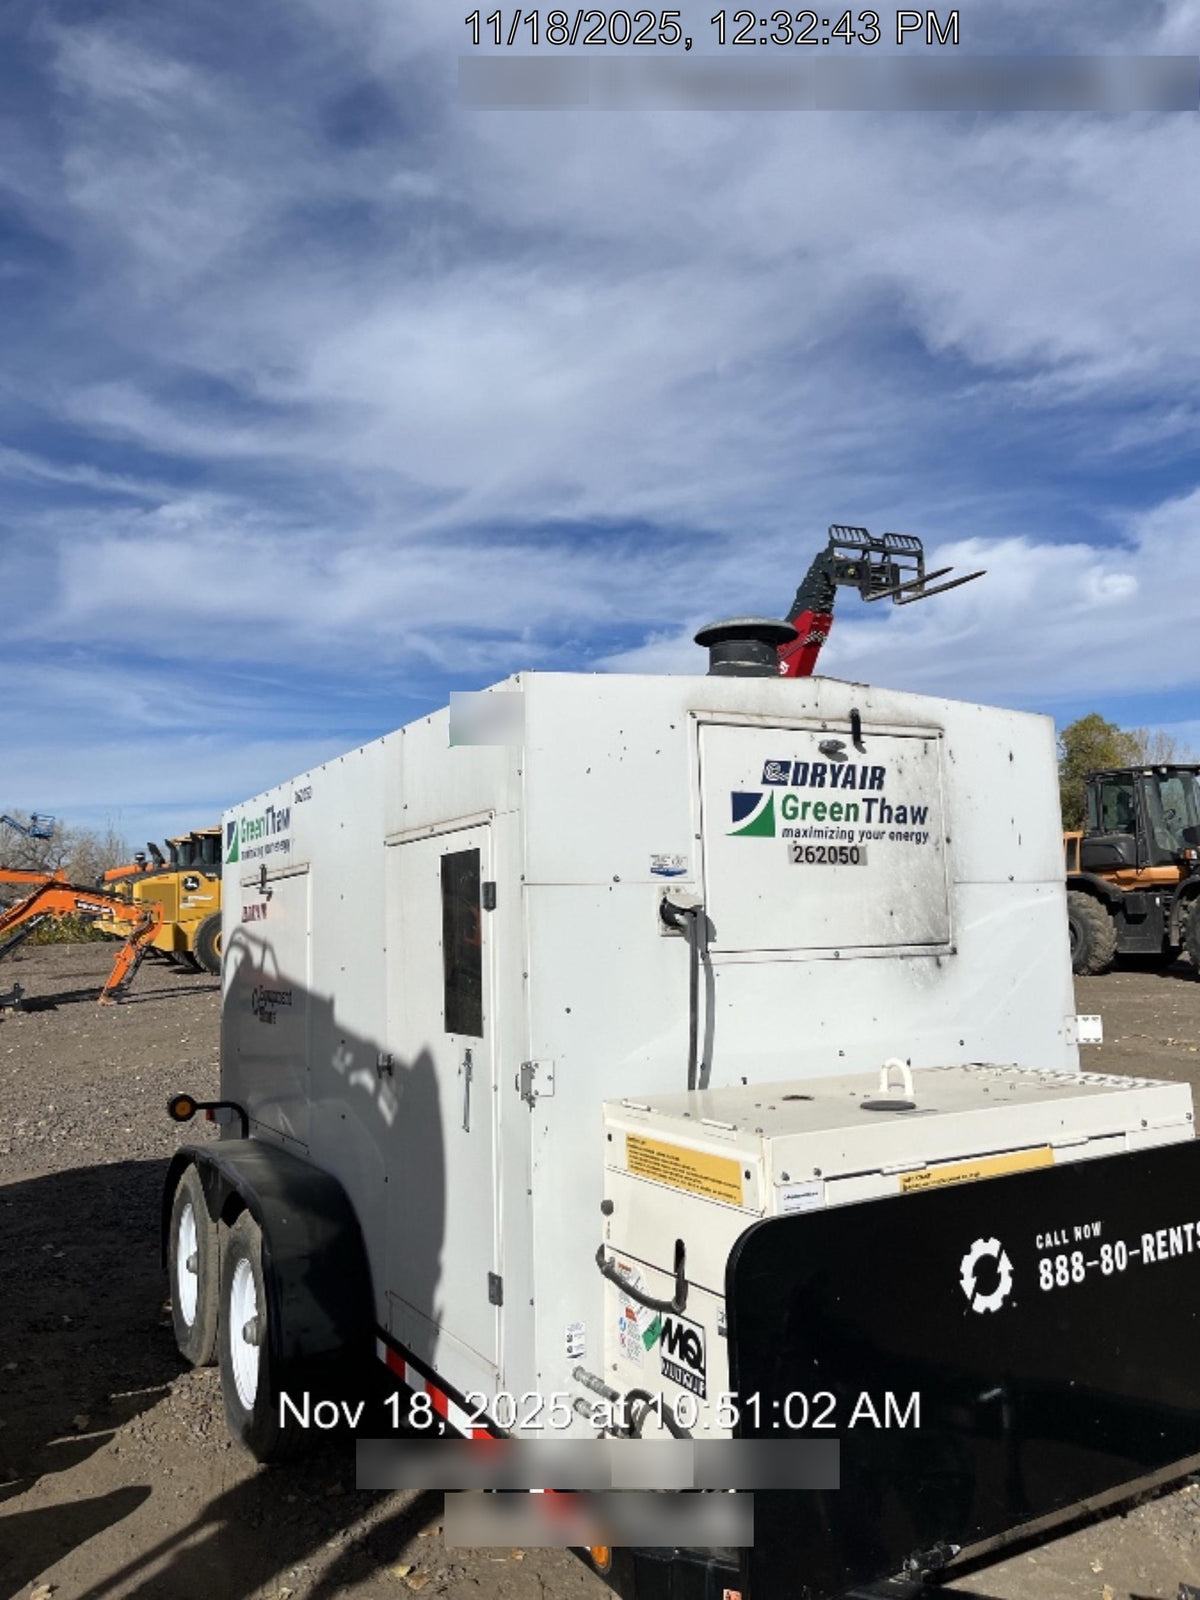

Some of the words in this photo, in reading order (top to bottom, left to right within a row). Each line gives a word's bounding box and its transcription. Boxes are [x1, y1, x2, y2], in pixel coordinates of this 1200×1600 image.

[791, 761, 886, 790] DRYAIR
[782, 794, 929, 825] GreenThaw
[782, 826, 854, 842] maximizing
[859, 831, 885, 842] your
[889, 831, 929, 844] energy
[793, 846, 860, 864] 262050
[1036, 1229, 1069, 1249] CALL
[1074, 1221, 1102, 1241] NOW
[660, 1317, 704, 1377] MQ
